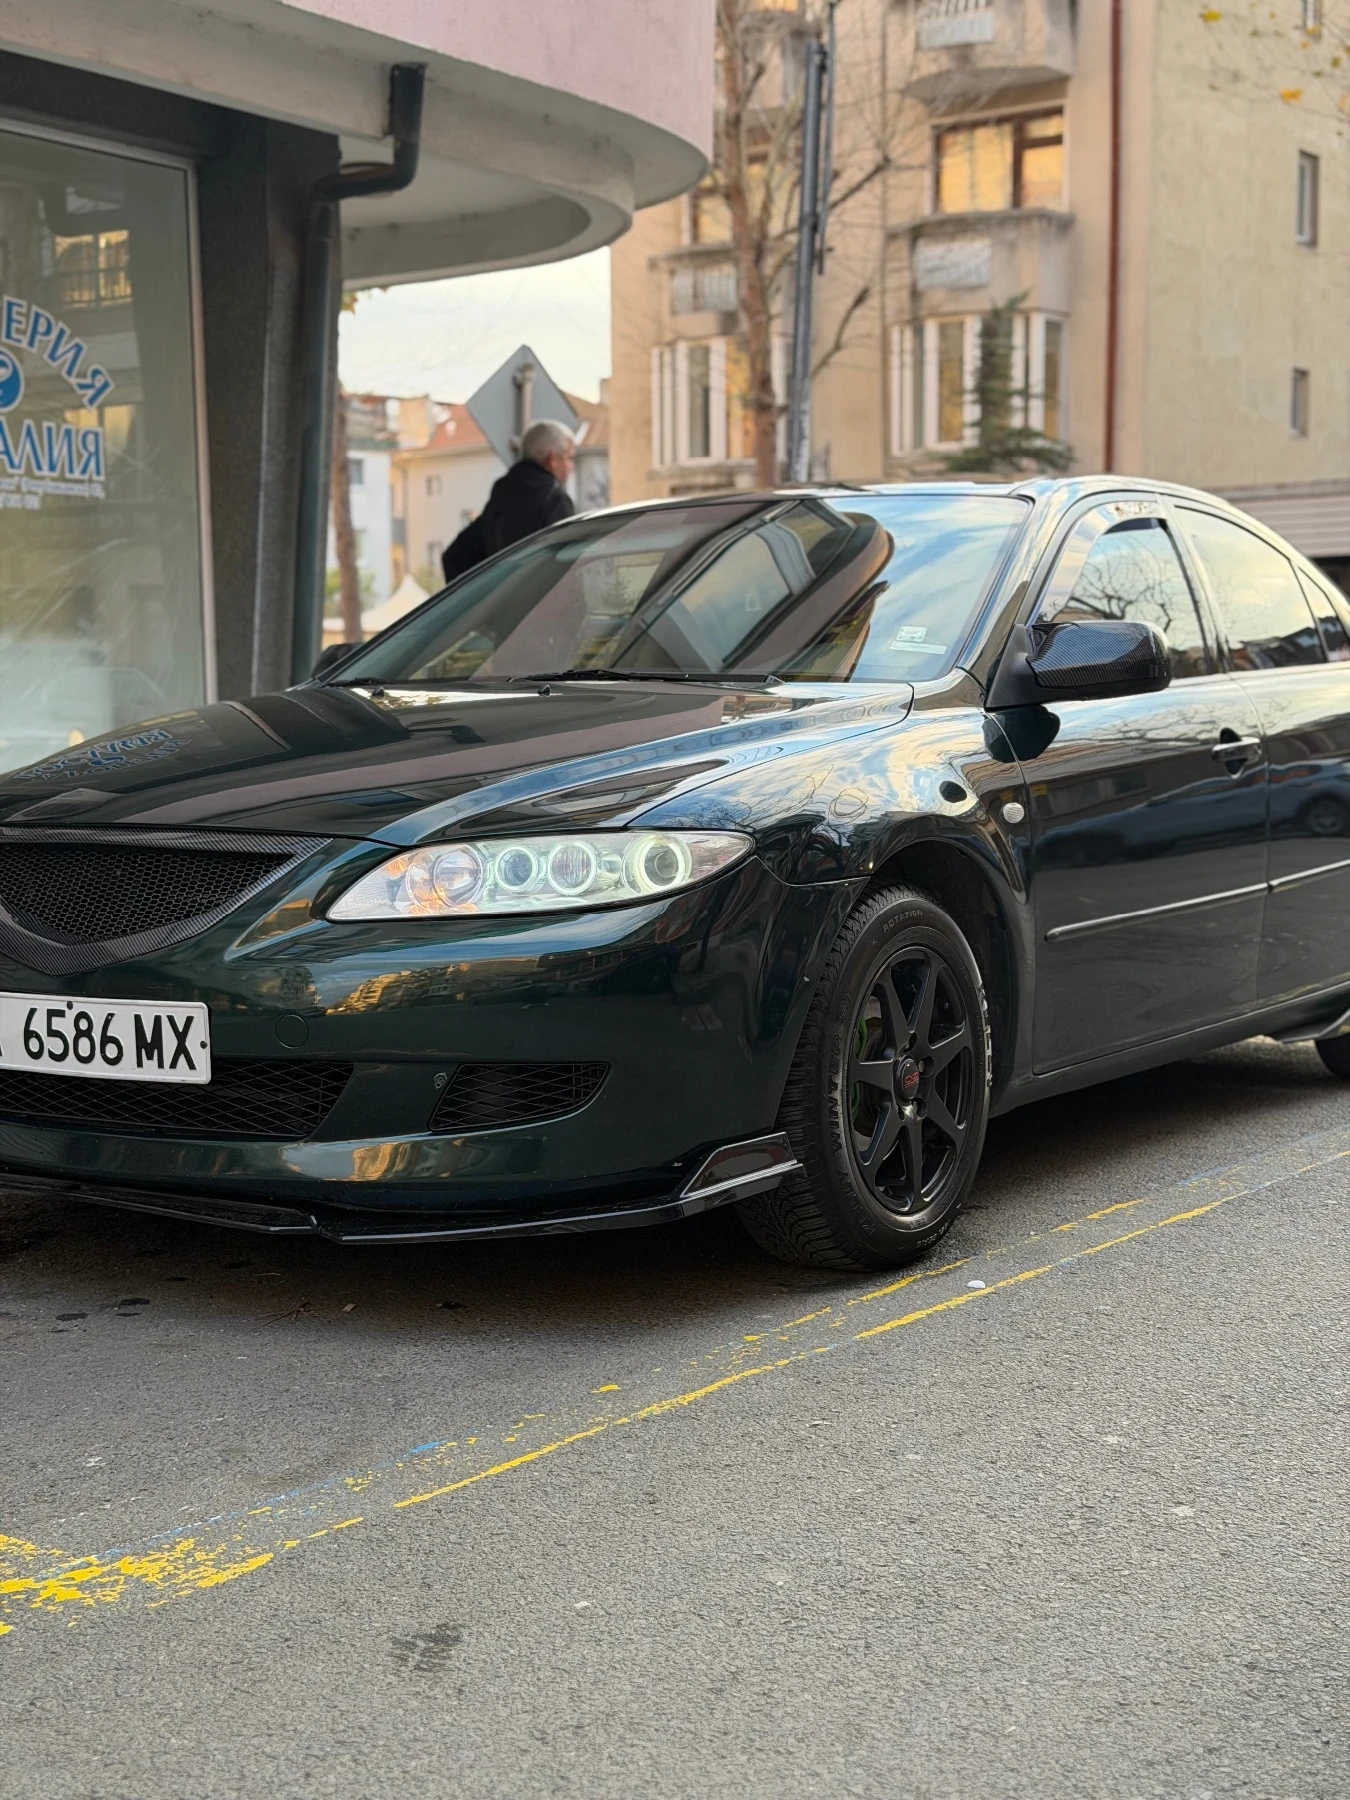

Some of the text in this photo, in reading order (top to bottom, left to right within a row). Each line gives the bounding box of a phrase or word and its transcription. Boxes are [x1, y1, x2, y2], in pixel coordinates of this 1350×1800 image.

[2, 297, 114, 408] ЕРИЯ
[882, 910, 923, 933] ROTATION
[24, 1007, 197, 1070] 6586 MX
[828, 1032, 843, 1156] WINTER
